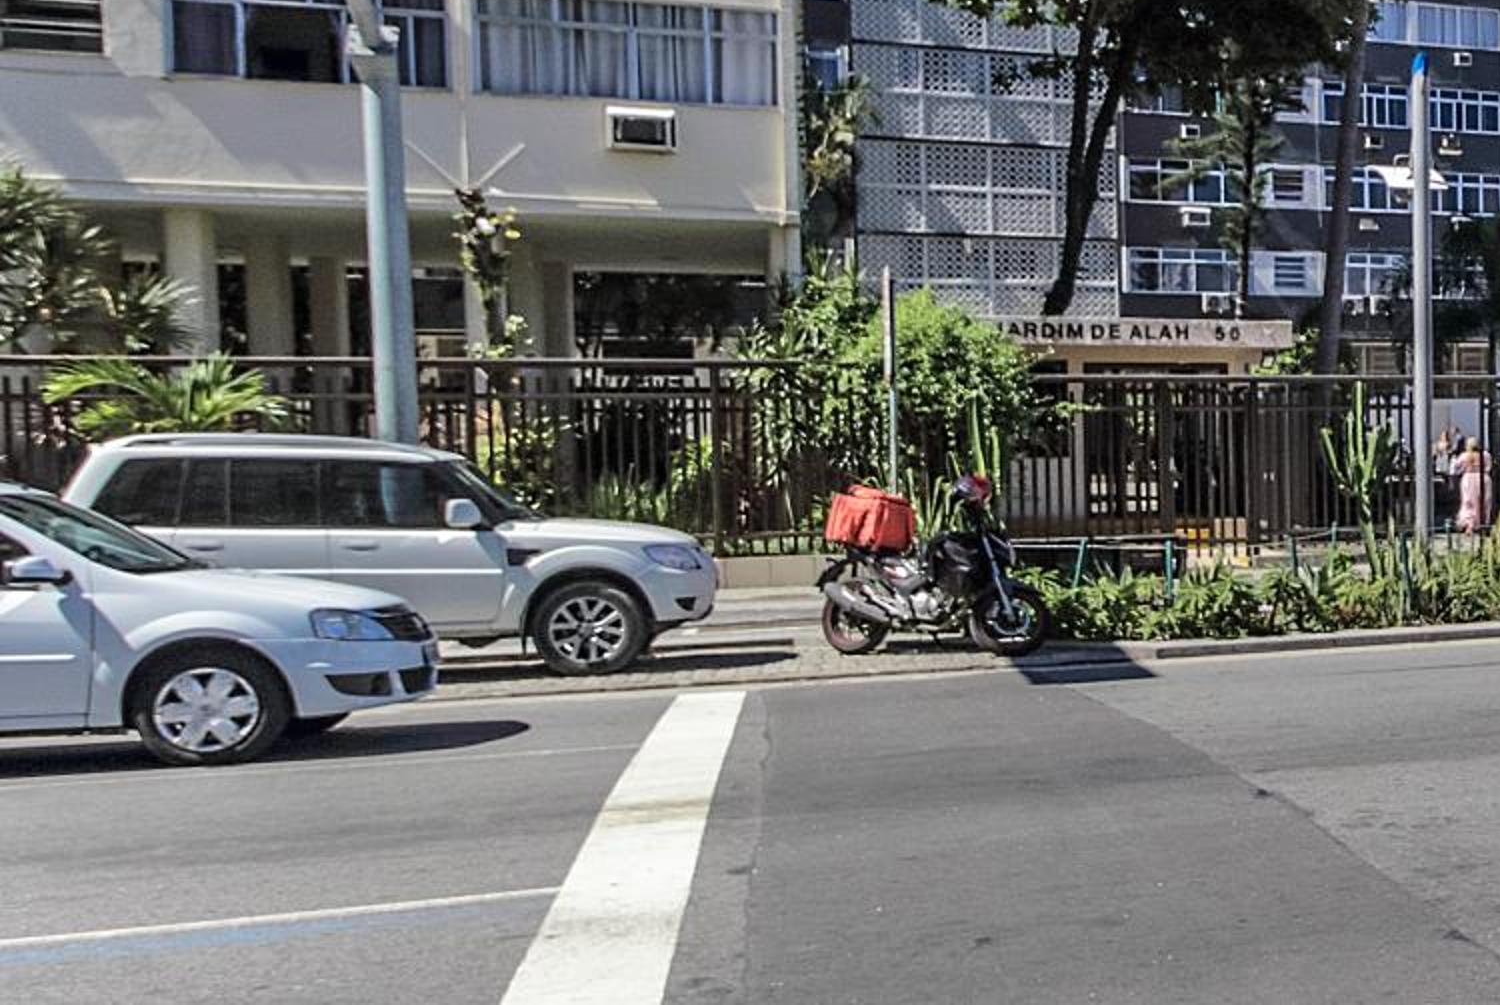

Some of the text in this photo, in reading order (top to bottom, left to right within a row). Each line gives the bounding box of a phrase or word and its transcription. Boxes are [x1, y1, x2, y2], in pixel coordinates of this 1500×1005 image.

[1091, 323, 1120, 340] DE
[1129, 323, 1189, 340] ALAH
[1215, 326, 1240, 341] 50
